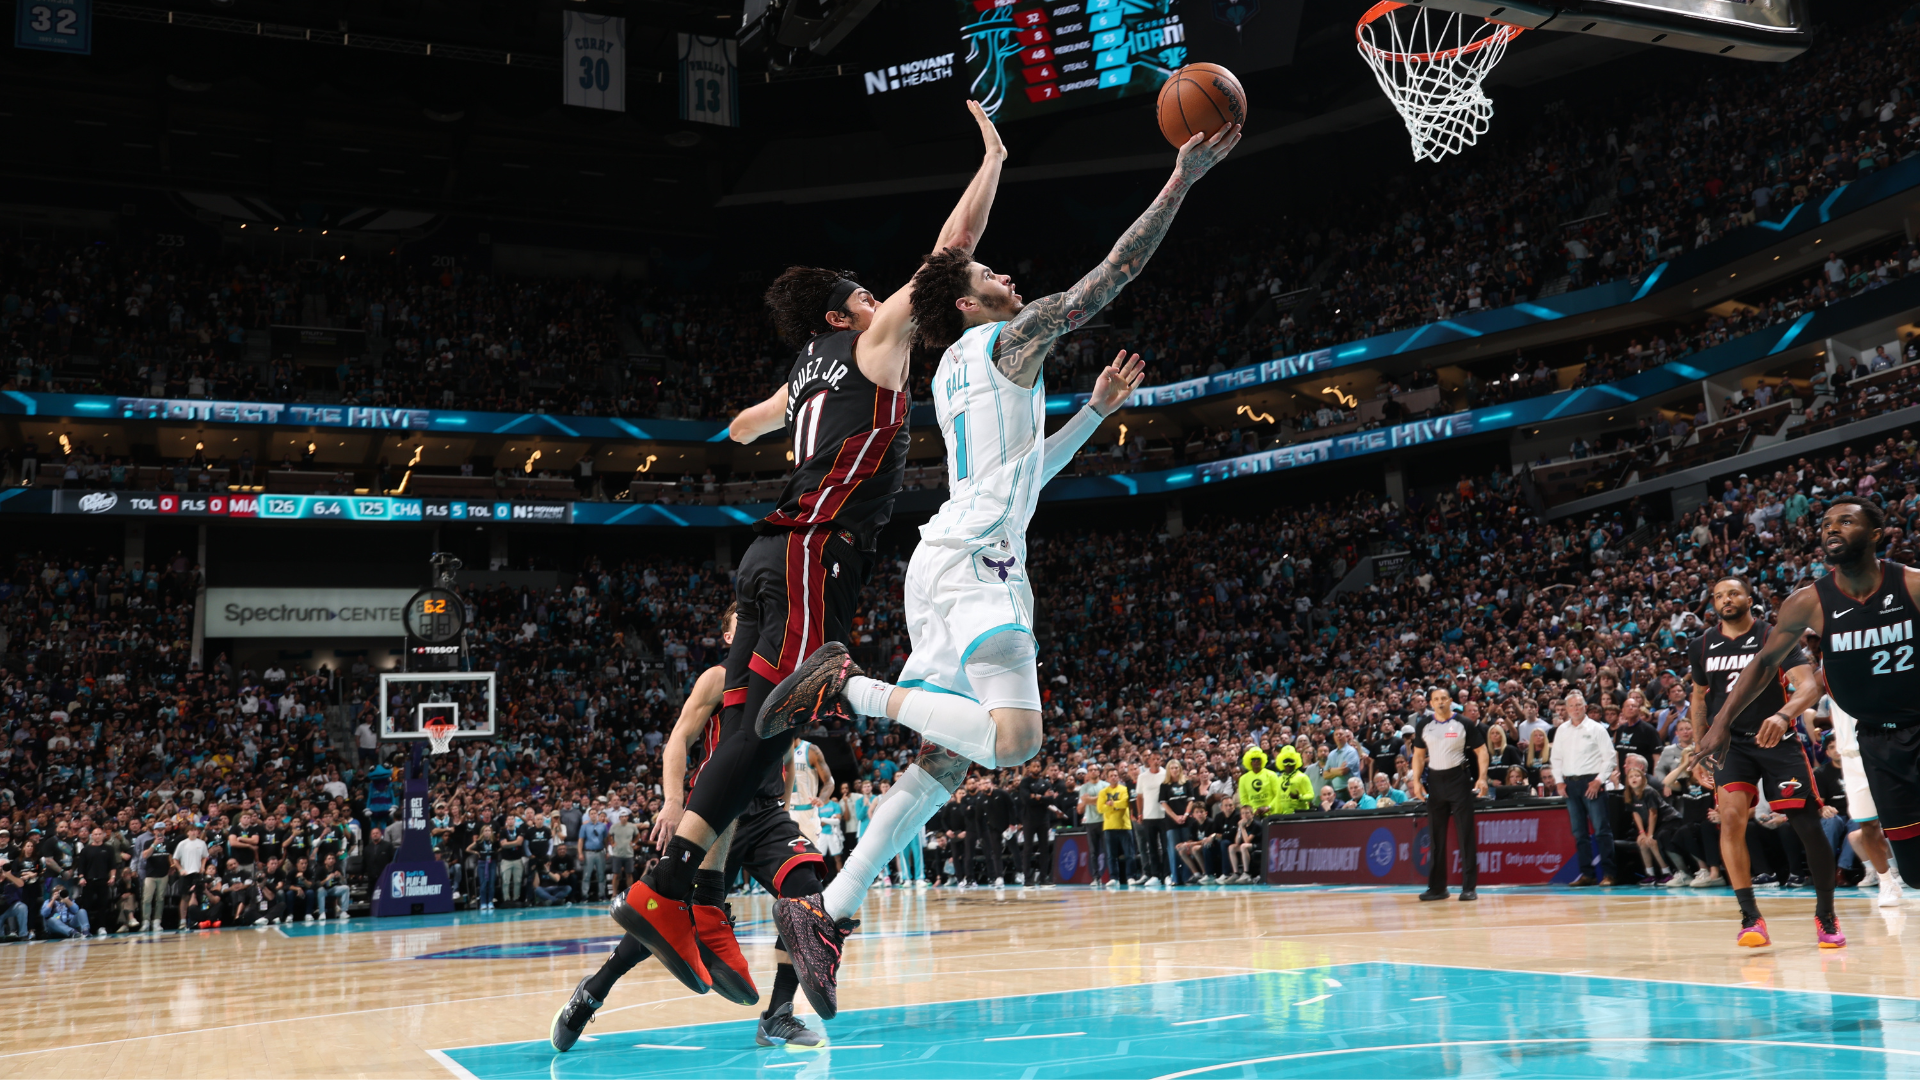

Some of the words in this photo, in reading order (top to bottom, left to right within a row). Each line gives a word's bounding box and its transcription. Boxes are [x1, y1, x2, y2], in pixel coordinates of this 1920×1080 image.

[30, 5, 78, 35] 32
[1026, 13, 1040, 24] 32
[1099, 16, 1108, 26] 6
[575, 37, 614, 54] CURRY
[579, 56, 610, 91] 30
[689, 60, 725, 76] PHILLS
[900, 52, 955, 75] NOVANT
[902, 66, 953, 87] HEALTH
[1108, 74, 1117, 84] 6
[695, 78, 720, 113] 13
[156, 233, 185, 247] 233
[431, 255, 456, 267] 201
[1213, 367, 1256, 388] THE
[1261, 349, 1332, 383] HIVE
[786, 356, 823, 421] JAQUEZ
[822, 359, 848, 391] JR.
[946, 364, 970, 401] BALL
[116, 397, 285, 423] PROTECT
[290, 407, 342, 422] THE
[348, 407, 429, 428] HIVE
[795, 389, 828, 468] 11
[953, 410, 968, 482] 1
[1196, 439, 1333, 483] PROTECT
[1338, 431, 1386, 452] THE
[1391, 411, 1473, 447] HIVE
[130, 499, 157, 510] TOL
[161, 498, 173, 510] 0
[181, 500, 205, 511] FLS
[210, 499, 222, 512] 0
[229, 499, 260, 513] MIA
[268, 500, 295, 513] 126
[313, 502, 341, 515] 6.4
[359, 501, 384, 515] 125
[392, 502, 421, 516] CHA
[426, 505, 448, 516] FLS
[453, 505, 462, 516] 5
[467, 505, 491, 517] TOL
[497, 506, 507, 517] 0
[1378, 557, 1404, 567] UTILITY
[224, 603, 330, 626] Spectrum
[1830, 619, 1914, 653] MIAMI
[425, 646, 460, 654] TISSOT
[1870, 644, 1915, 676] 22
[410, 797, 424, 808] GET
[411, 807, 424, 818] THE
[413, 818, 427, 830] App
[1477, 818, 1539, 845] TOMORROW
[1278, 848, 1307, 872] PLAY-IN
[1308, 847, 1361, 872] TOURNAMENT
[1490, 851, 1503, 873] ET
[1505, 852, 1523, 867] Only
[1524, 855, 1535, 864] on
[1536, 851, 1562, 867] prime
[405, 875, 428, 887] PLAY-IN
[405, 884, 442, 897] TOURNAMENT
